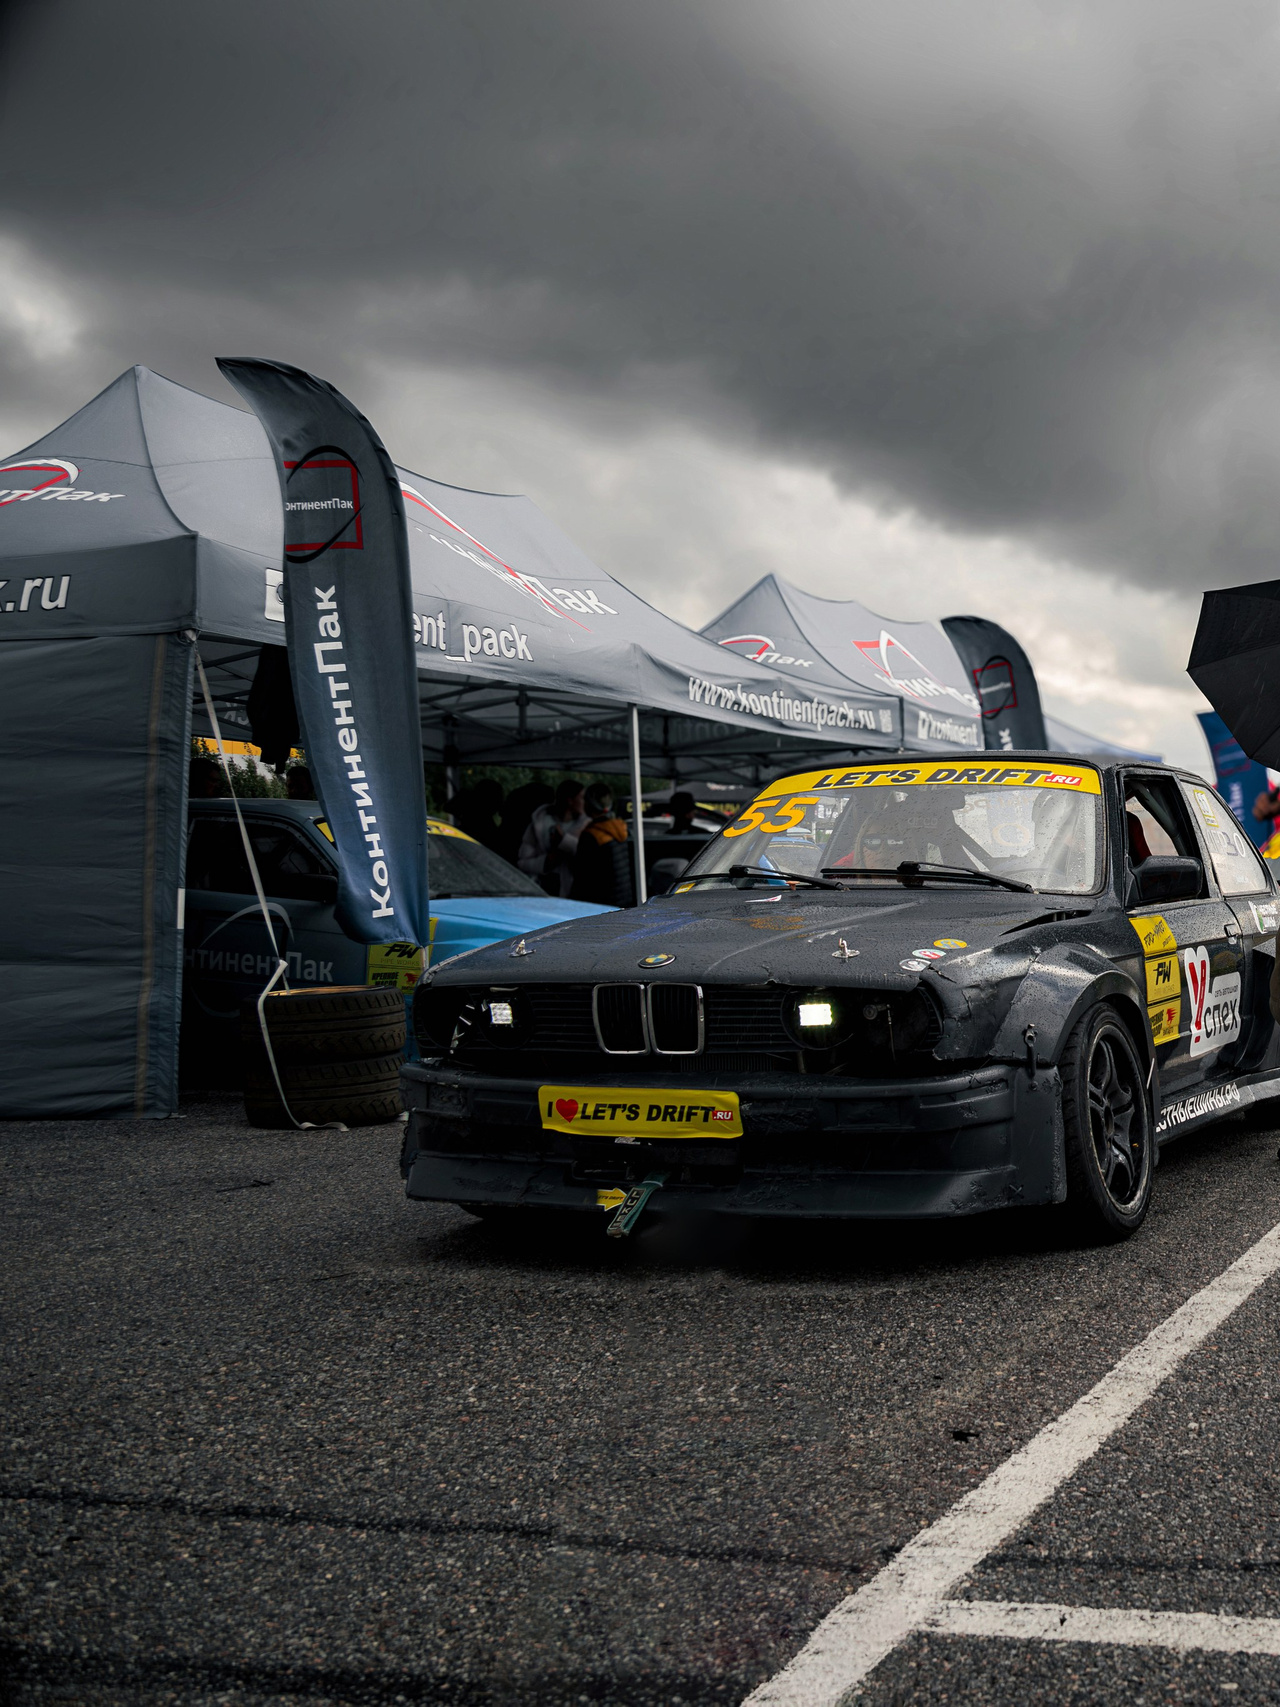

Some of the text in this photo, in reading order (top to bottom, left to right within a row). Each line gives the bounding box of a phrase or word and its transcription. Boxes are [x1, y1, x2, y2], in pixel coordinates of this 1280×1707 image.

[688, 676, 877, 732] www.kontinentpack.ru
[314, 584, 396, 919] КонтинентПак
[811, 769, 921, 790] LET'S
[722, 797, 820, 838] 55
[547, 1101, 553, 1118] I
[580, 1102, 640, 1121] LET'S
